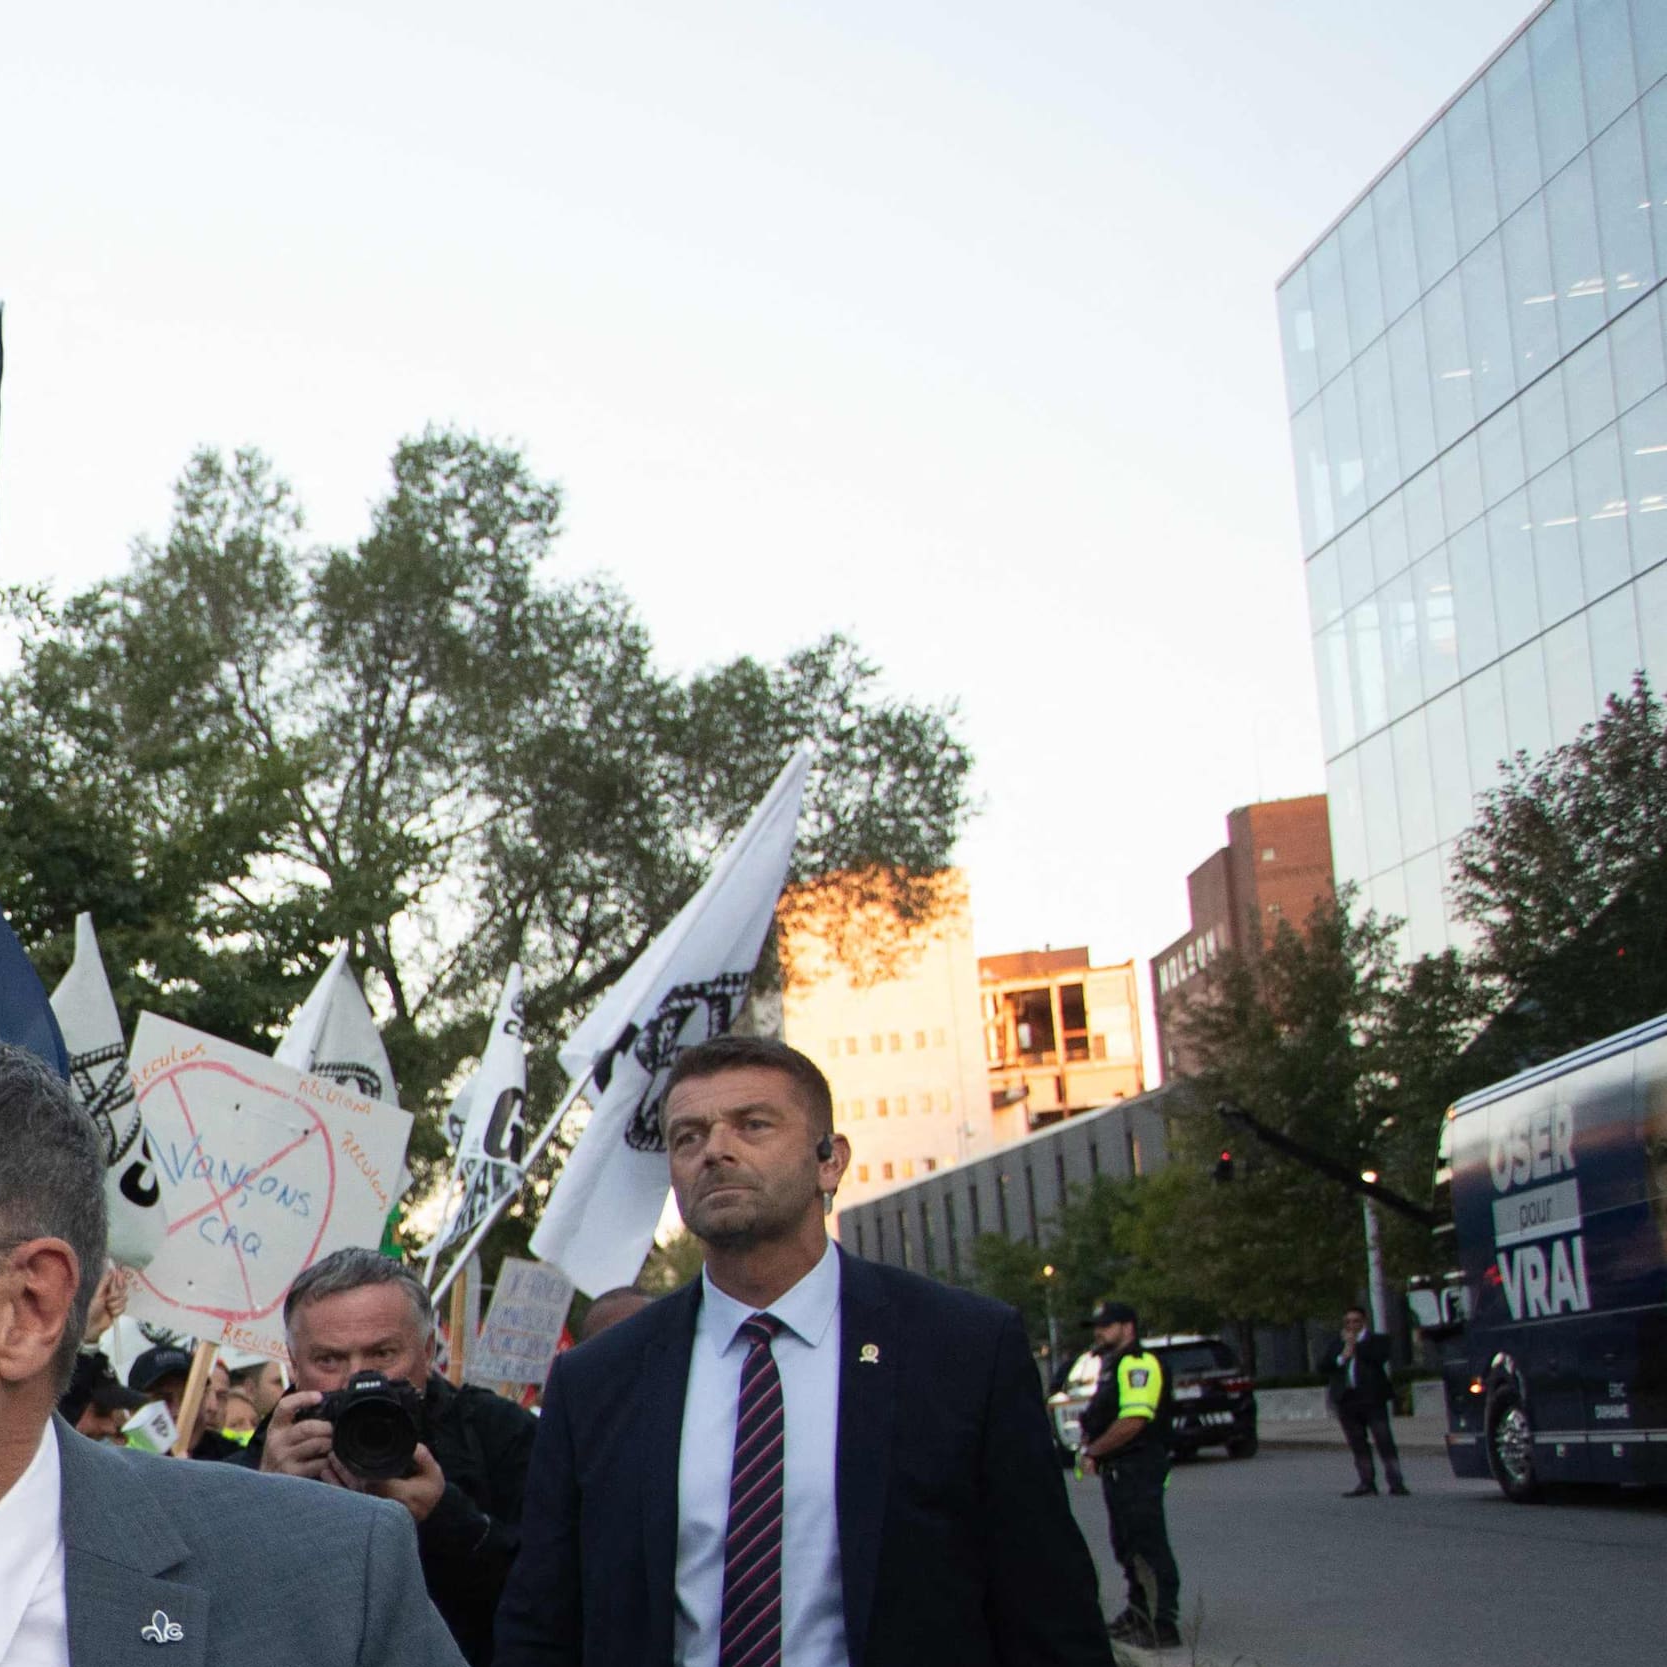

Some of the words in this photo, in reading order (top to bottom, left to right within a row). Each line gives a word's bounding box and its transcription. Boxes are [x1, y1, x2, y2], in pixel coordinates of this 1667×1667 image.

[1489, 1103, 1576, 1194] OSER
[199, 1216, 263, 1260] CAQ
[1519, 1197, 1552, 1231] pour
[1496, 1236, 1591, 1321] VRAI
